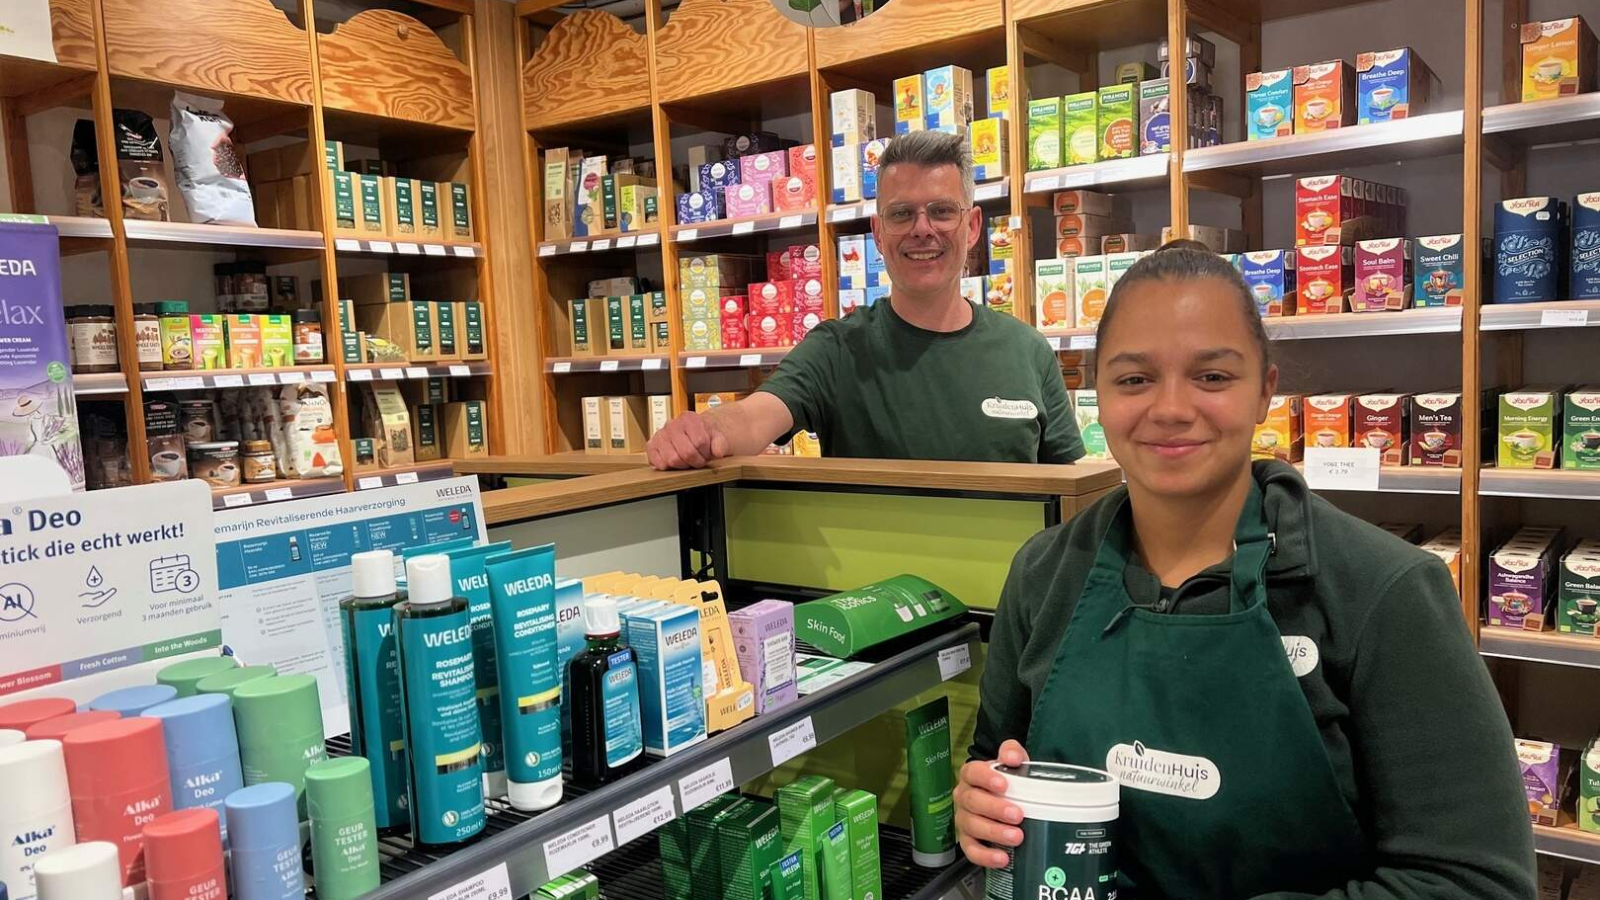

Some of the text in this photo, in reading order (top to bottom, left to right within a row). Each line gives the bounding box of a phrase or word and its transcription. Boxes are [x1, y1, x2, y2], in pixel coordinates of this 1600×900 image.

[1551, 40, 1575, 48] Lemon
[1362, 69, 1404, 80] Breathe Deep
[1508, 248, 1543, 263] SELECTION
[0, 299, 44, 324] lax
[1367, 414, 1388, 422] Ginger
[436, 484, 472, 498] WELEDA
[29, 509, 82, 531] Deo
[257, 508, 334, 528] Revitaliserende
[336, 498, 406, 516] Haarverzorging
[45, 539, 75, 558] die
[82, 533, 122, 552] echt
[127, 523, 184, 545] werkt!
[311, 541, 327, 550] NEW
[504, 574, 553, 597] WELEDA
[150, 594, 204, 611] Voor minimaal
[76, 610, 122, 625] Verzorgend
[148, 609, 184, 621] maanden
[185, 602, 213, 614] gebruik
[516, 603, 550, 618] ROSEMARY
[557, 606, 581, 623] EDA
[514, 613, 555, 630] REVITALISING
[514, 620, 555, 638] CONDITIONER
[765, 617, 787, 632] WELEDA
[665, 627, 697, 646] WELEDA
[807, 618, 845, 644] Skin Food
[155, 636, 208, 654] Into the Woods
[80, 655, 127, 671] Fresh Cotton
[611, 653, 629, 665] TESTER
[16, 671, 52, 685] Blossom
[609, 668, 632, 683] WELEDA
[918, 717, 947, 735] WELEDA
[926, 747, 949, 766] Skin Food
[1115, 751, 1209, 782] KruidenHuis
[184, 771, 222, 788] Alka
[1120, 769, 1199, 793] natuurwinkel
[195, 787, 215, 798] Deo
[124, 796, 161, 816] Alka
[135, 814, 155, 826] Deo
[653, 810, 672, 823] €12,99
[853, 808, 874, 823] WELEDA
[12, 827, 54, 846] Alka
[338, 823, 364, 836] GEUR
[755, 825, 779, 849] WELEDA
[334, 830, 368, 846] TESTER
[592, 835, 608, 847] €9,99
[24, 844, 47, 857] Deo
[782, 855, 797, 868] TESTER
[190, 879, 217, 894] GEUR
[458, 880, 484, 895] SHAMPOO
[489, 887, 507, 900] €9,99
